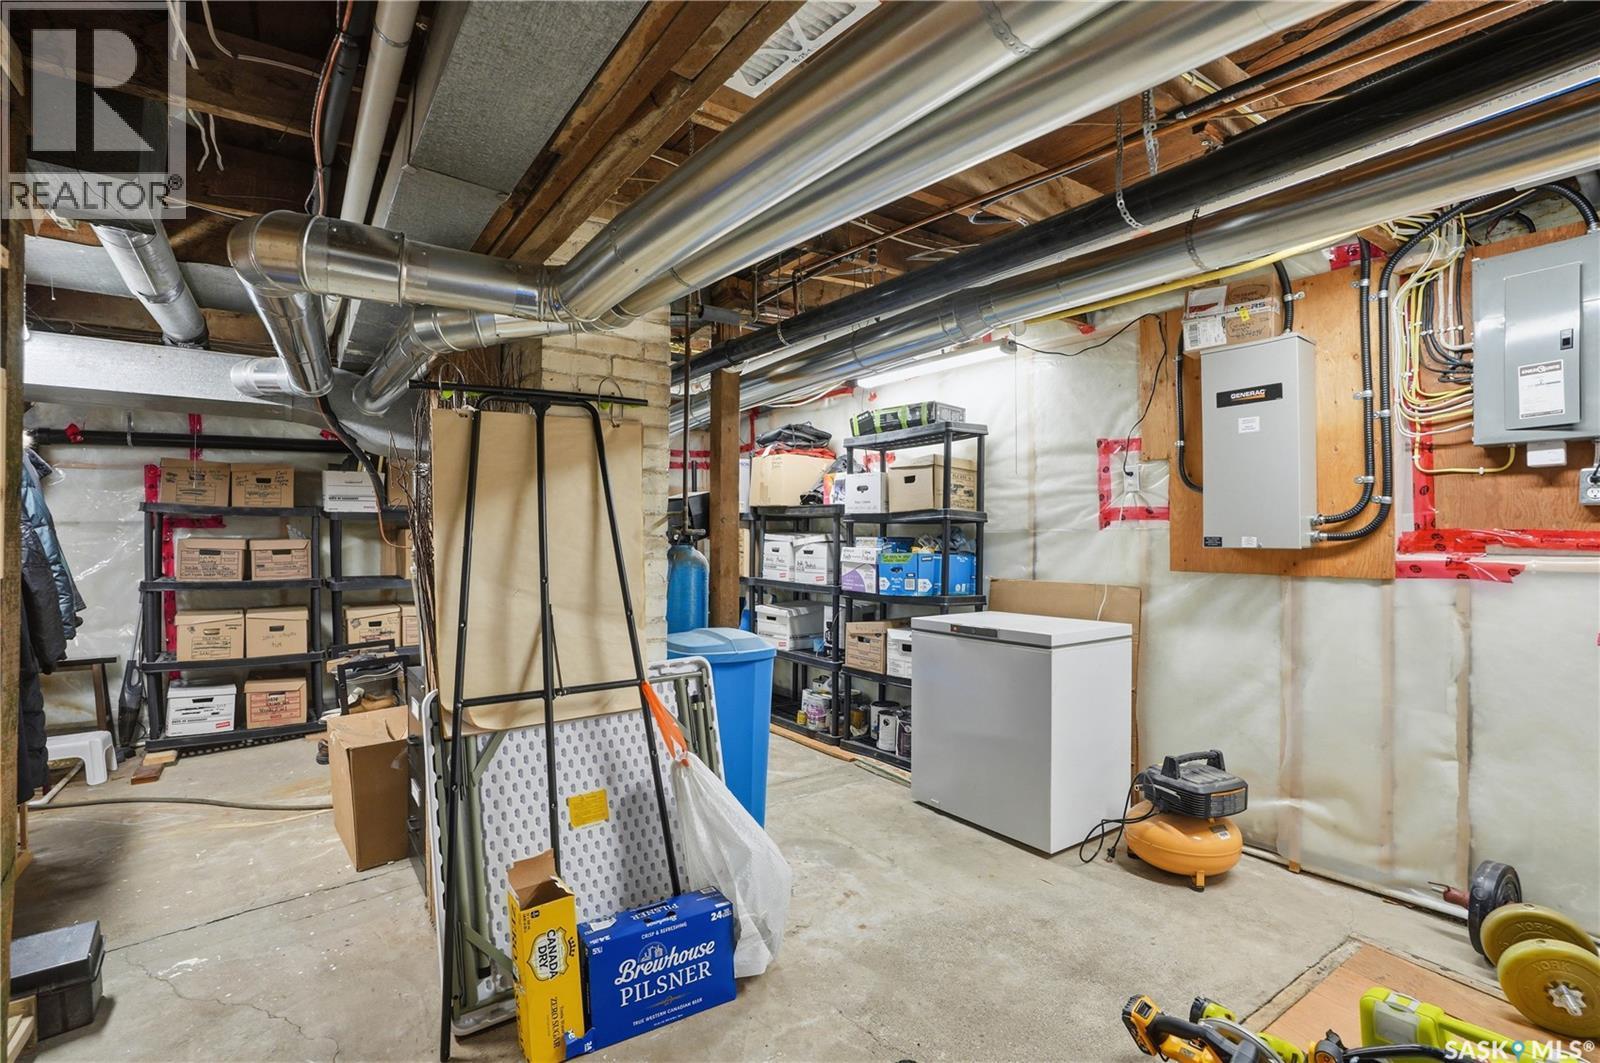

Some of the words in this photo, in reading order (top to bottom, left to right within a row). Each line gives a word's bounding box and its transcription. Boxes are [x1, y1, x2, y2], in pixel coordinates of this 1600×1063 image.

[1230, 388, 1267, 399] GENERAC
[711, 910, 722, 922] 24
[1515, 921, 1553, 932] YORK
[641, 932, 655, 940] CRISP
[538, 945, 548, 968] DRY
[547, 929, 558, 979] CANADA
[614, 940, 715, 985] Brewhouse
[1532, 960, 1570, 971] YORK
[620, 961, 712, 1007] PILSNER
[550, 996, 558, 1020] ZERO
[632, 1018, 645, 1027] TRUE
[645, 1010, 667, 1022] WESTERN
[667, 1002, 692, 1014] CANADIAN
[691, 997, 703, 1005] BEER
[552, 1020, 560, 1048] SUGAR
